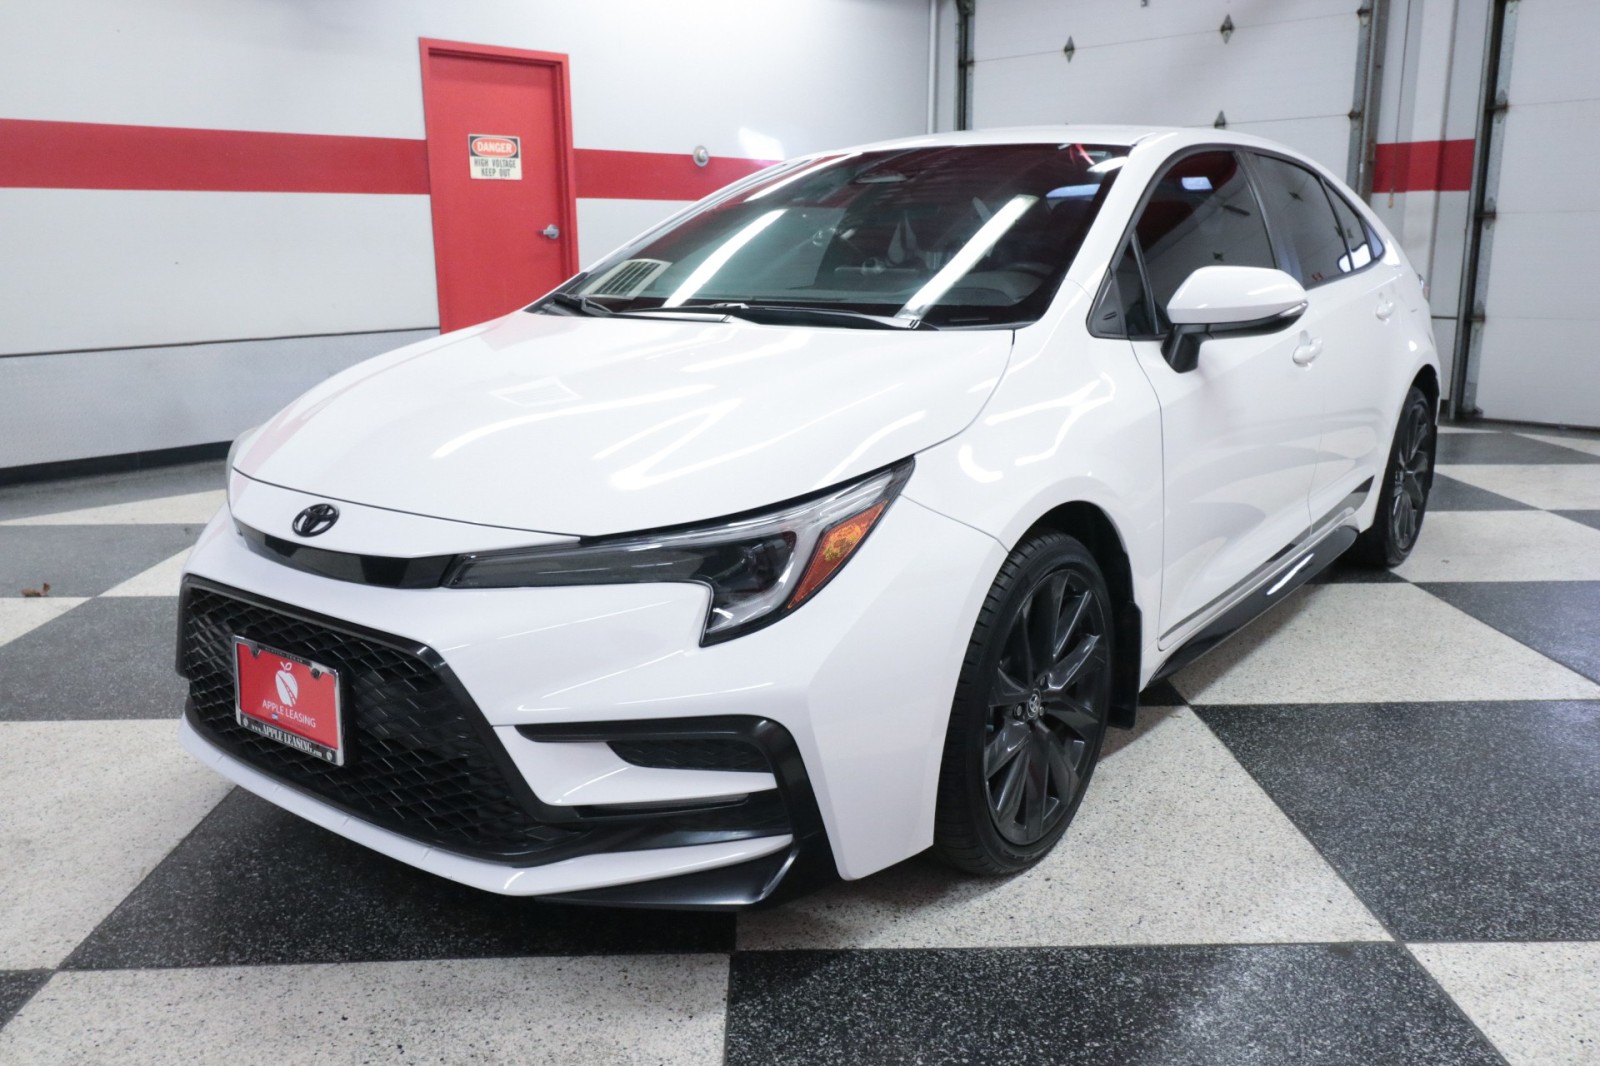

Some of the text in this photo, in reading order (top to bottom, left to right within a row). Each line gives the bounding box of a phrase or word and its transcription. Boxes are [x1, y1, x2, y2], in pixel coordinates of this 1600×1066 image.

[477, 141, 512, 153] DANGER
[474, 158, 516, 168] HIGH VOLTAGE
[481, 168, 510, 177] KEEP OUT
[262, 699, 316, 728] APPLE LEASING
